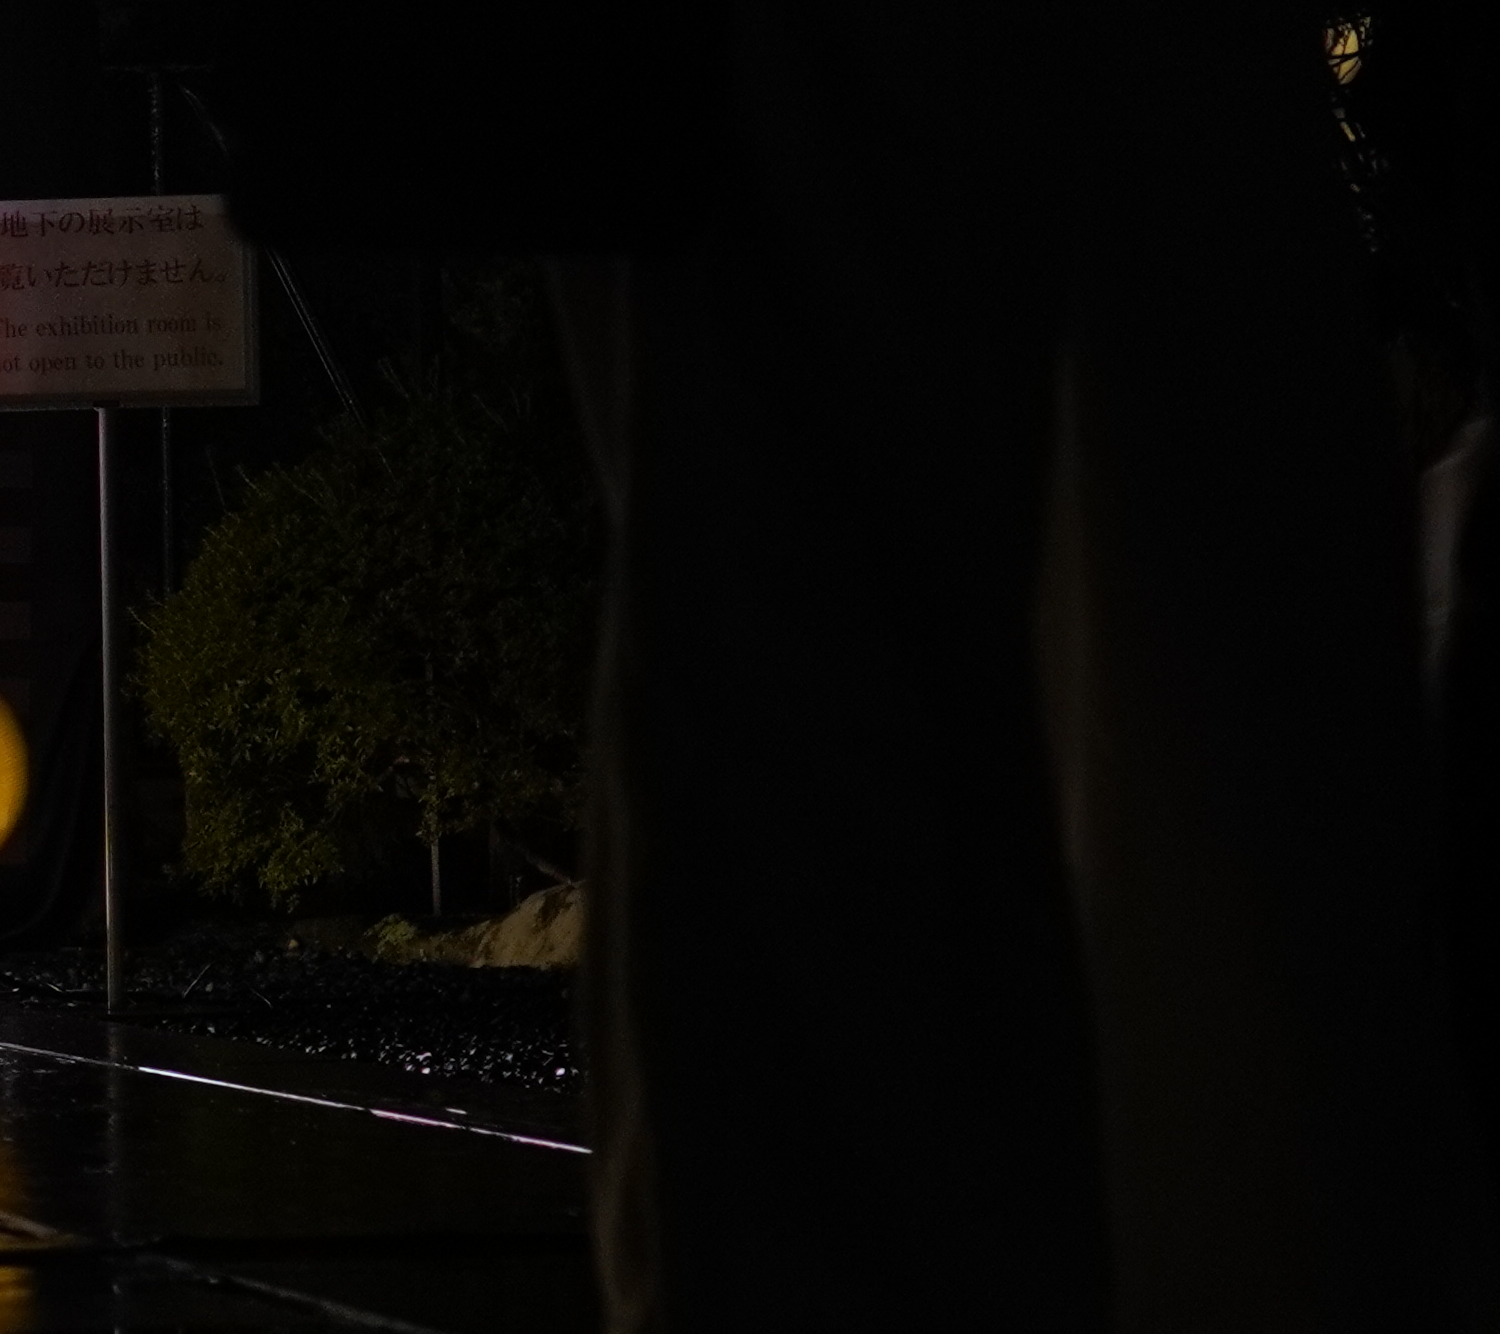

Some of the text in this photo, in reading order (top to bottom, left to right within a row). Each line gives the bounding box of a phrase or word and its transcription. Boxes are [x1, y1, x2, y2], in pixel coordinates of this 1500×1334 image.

[1, 205, 204, 238] 地下の展示室は
[36, 313, 139, 338] exhibition
[147, 316, 197, 334] room
[207, 312, 223, 332] is
[28, 355, 77, 376] open
[86, 354, 106, 371] to
[112, 348, 145, 370] the
[152, 345, 223, 371] public.
